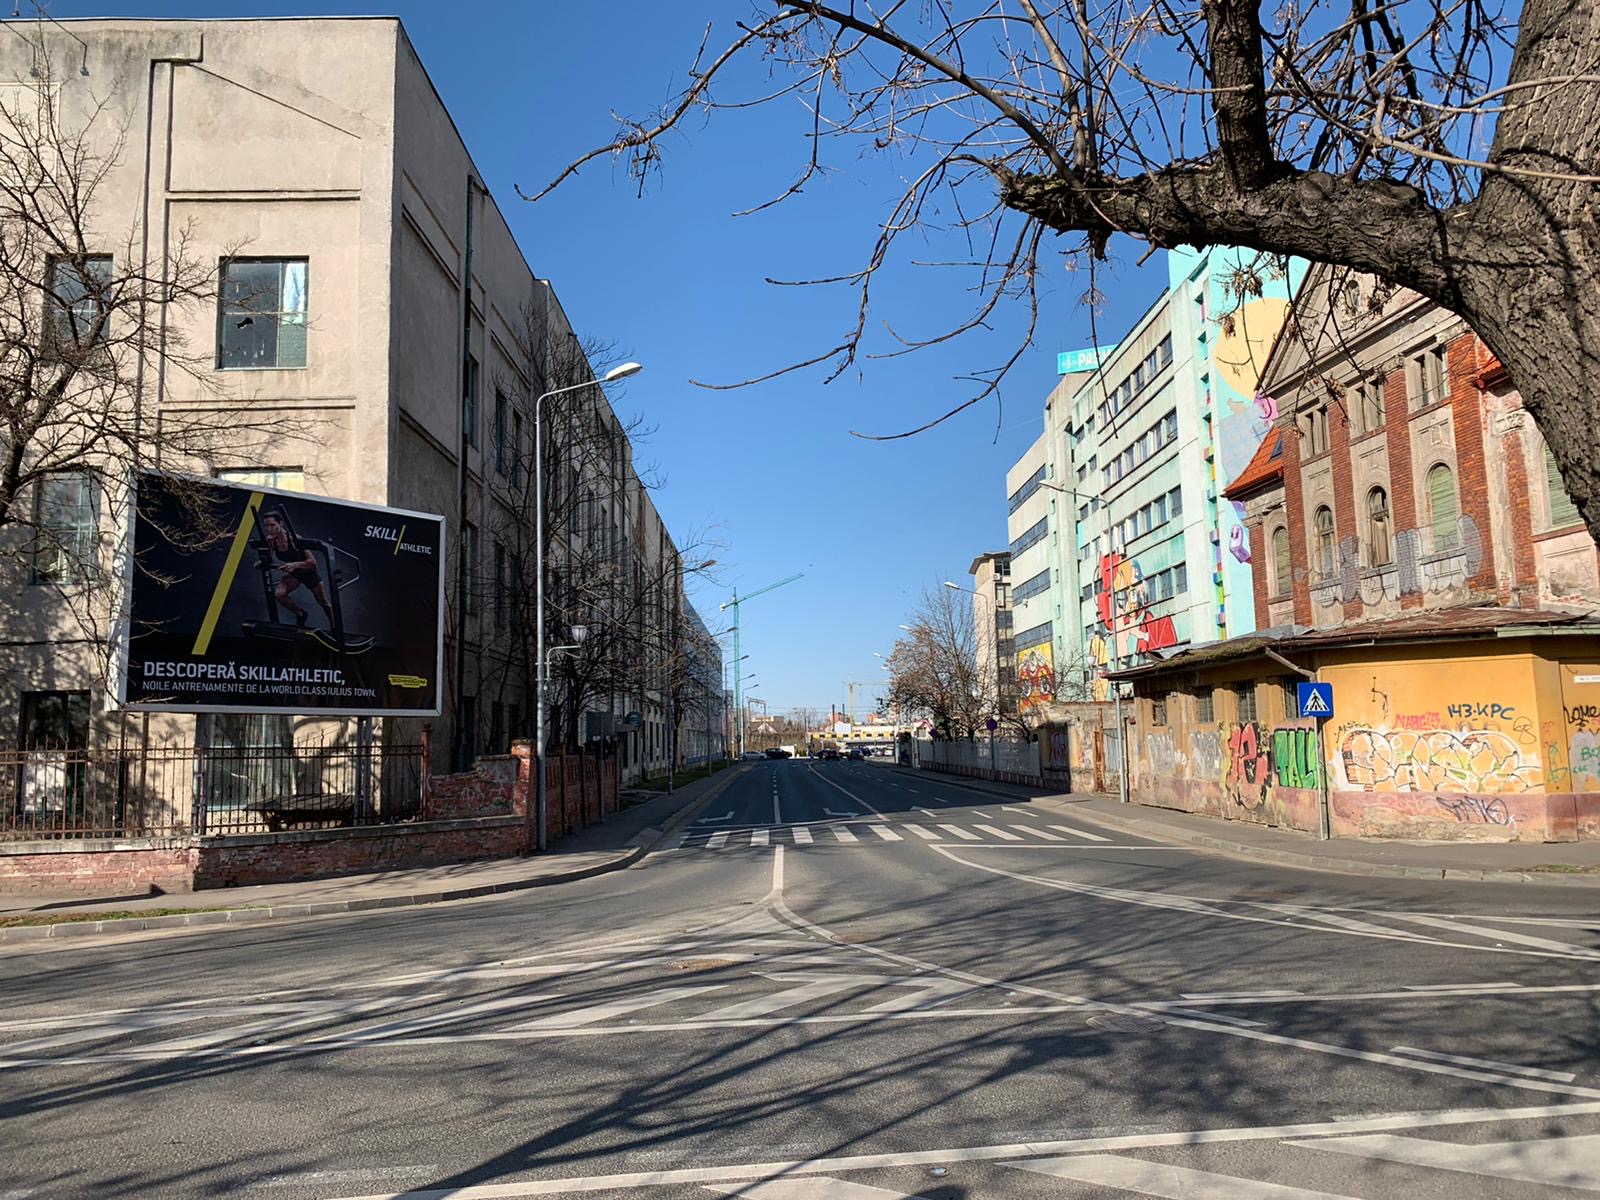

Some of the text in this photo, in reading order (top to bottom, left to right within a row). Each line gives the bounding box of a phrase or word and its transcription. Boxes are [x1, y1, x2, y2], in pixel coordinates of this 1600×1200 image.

[364, 524, 432, 555] SKILL ATHLETIC
[143, 661, 346, 684] DESCOPERĂ SKILLATHLETIC,
[142, 680, 377, 698] NOILE ANTRENAMENTE DE LA WORLD CLASS IULIUS TOWN.
